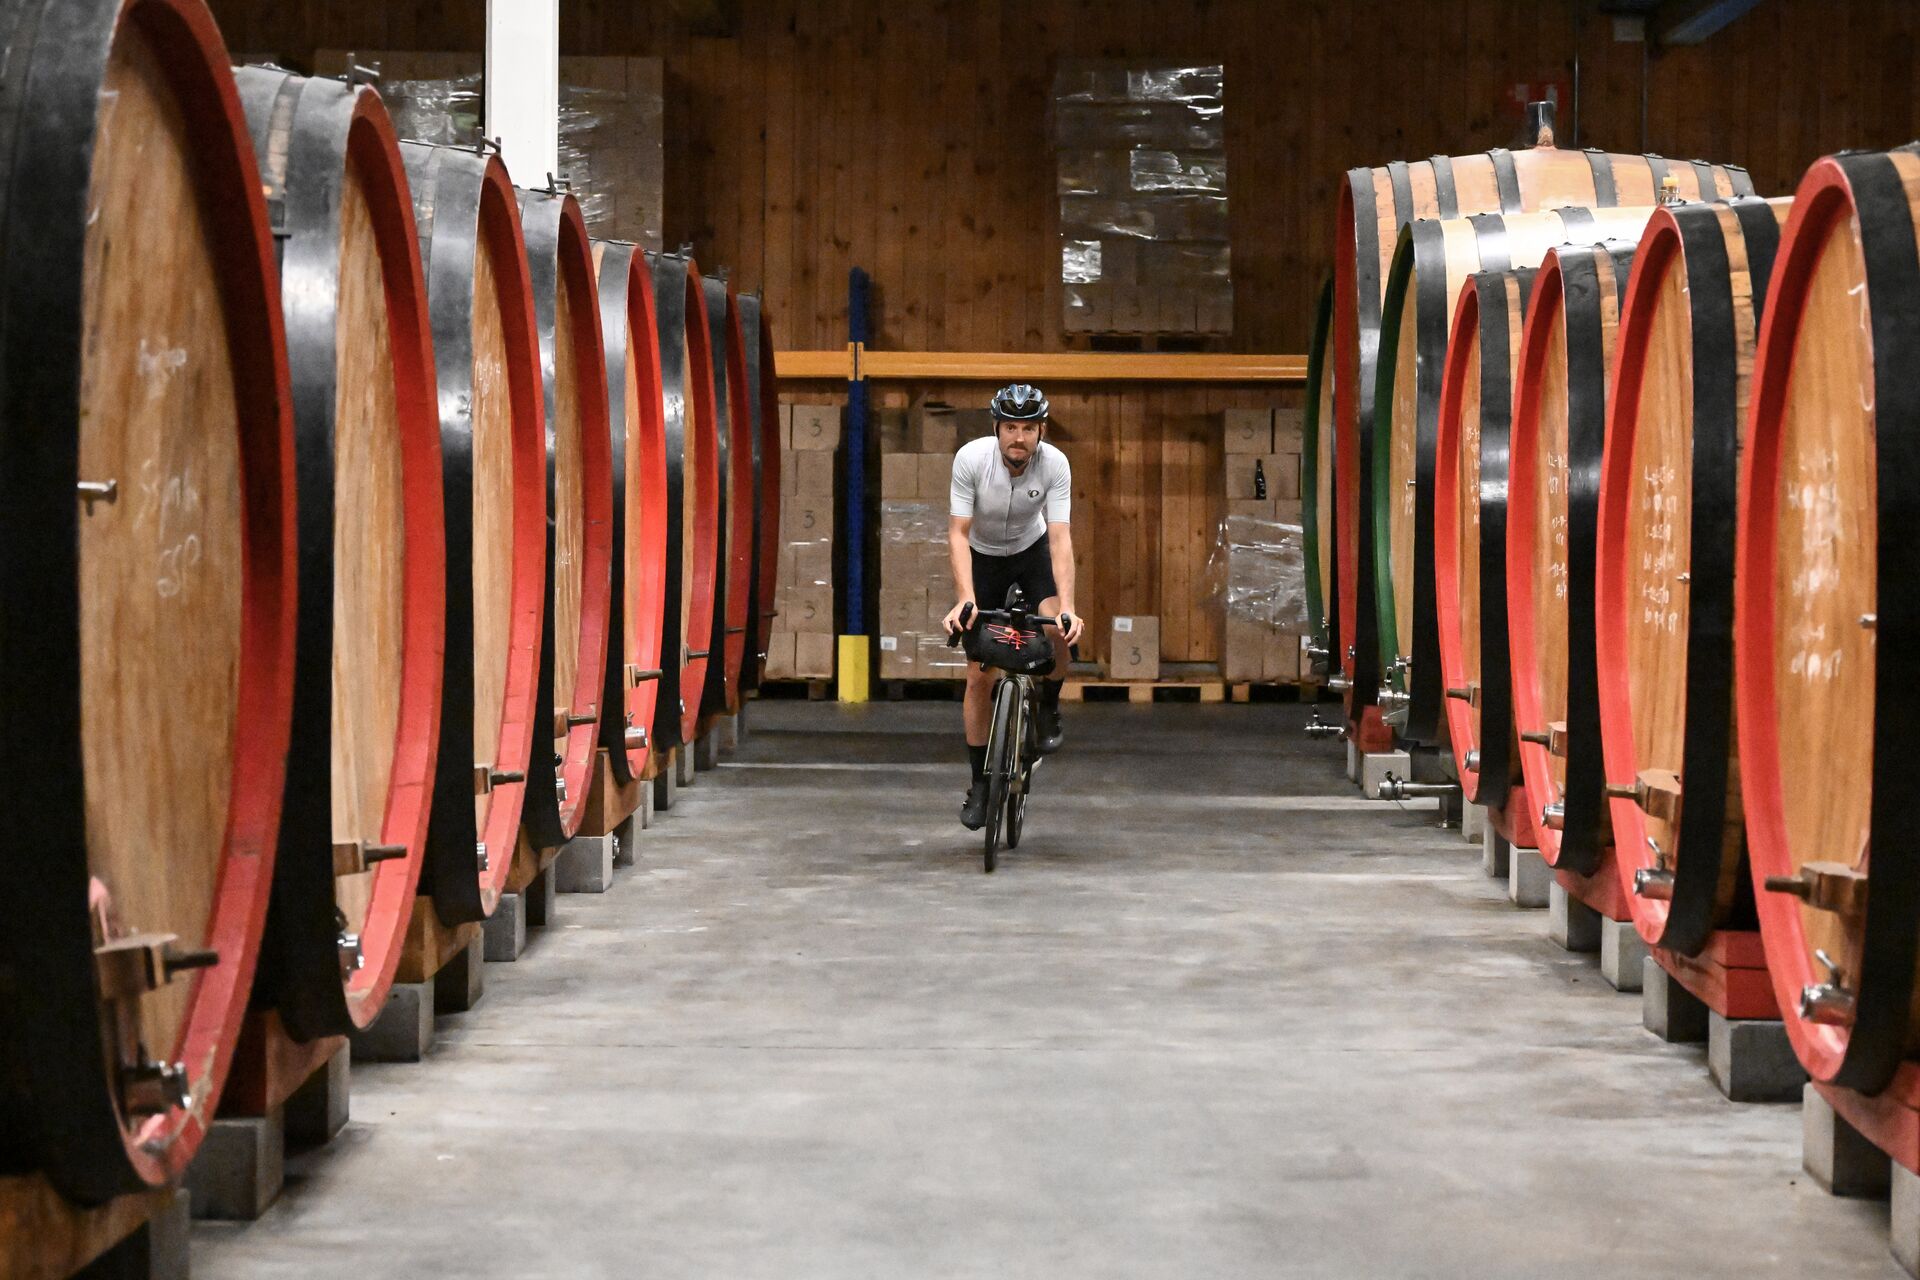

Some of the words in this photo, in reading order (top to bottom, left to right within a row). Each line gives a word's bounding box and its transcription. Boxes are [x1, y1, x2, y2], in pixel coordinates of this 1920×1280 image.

[810, 418, 822, 437] 3
[803, 510, 815, 528] 3
[805, 600, 816, 619] 3
[1130, 646, 1142, 665] 3
